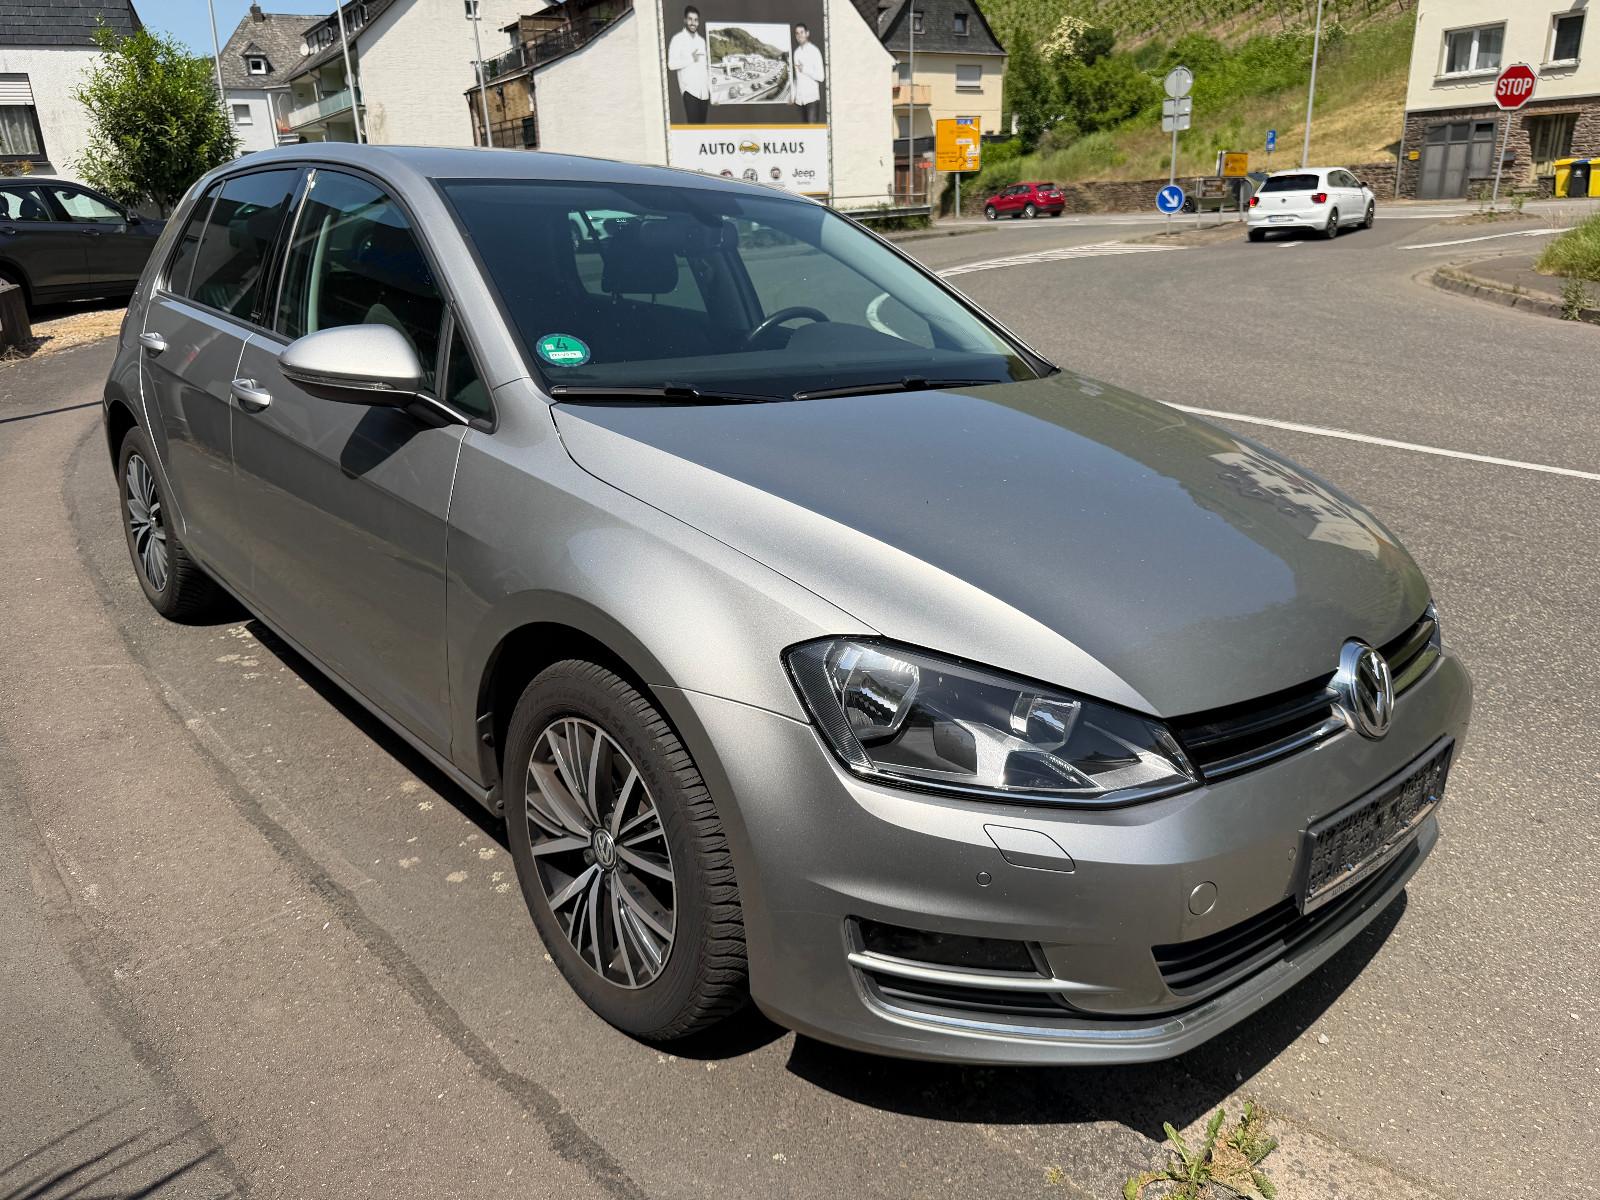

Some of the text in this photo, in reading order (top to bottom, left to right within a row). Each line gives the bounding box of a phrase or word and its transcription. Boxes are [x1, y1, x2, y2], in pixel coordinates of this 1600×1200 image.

[1497, 77, 1533, 96] STOP
[699, 141, 805, 156] AUTO KLAUS
[791, 168, 816, 179] Jeep
[556, 337, 569, 351] 4
